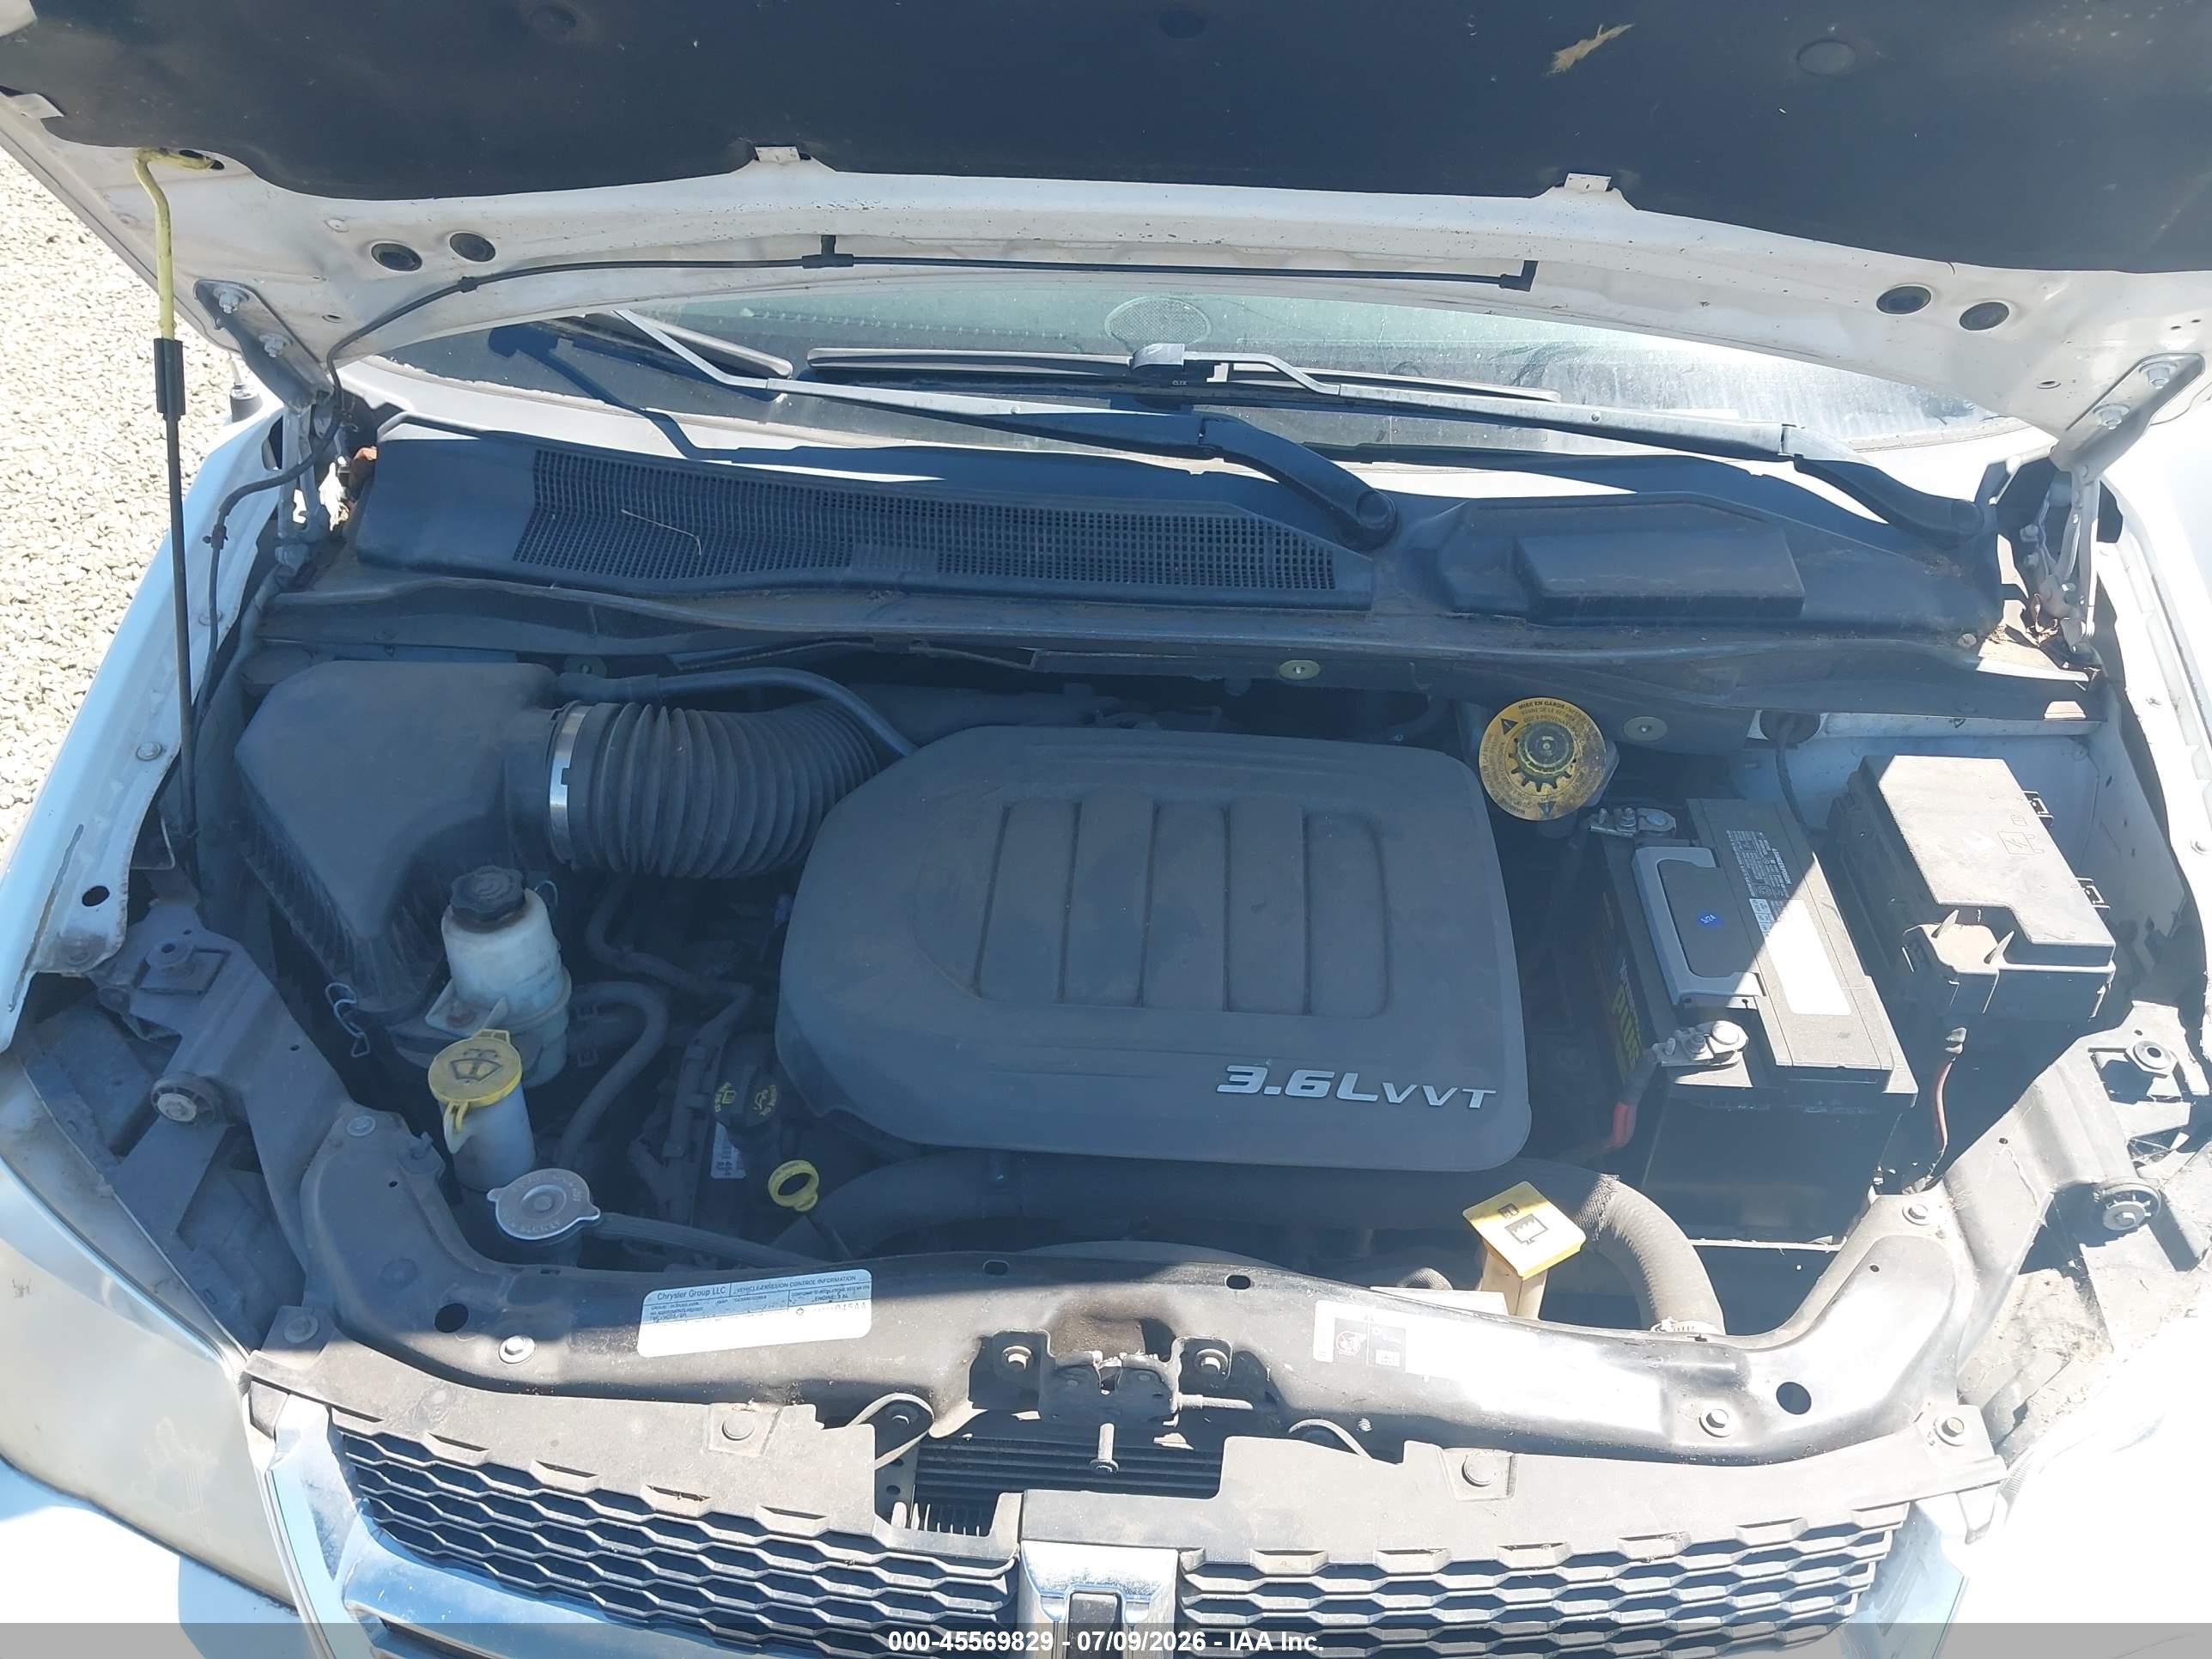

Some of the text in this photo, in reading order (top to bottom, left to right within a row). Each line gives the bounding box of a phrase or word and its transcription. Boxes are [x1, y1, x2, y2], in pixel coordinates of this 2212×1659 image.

[1518, 701, 1534, 709] MISE
[1544, 700, 1565, 709] GARDE
[737, 1285, 760, 1293] VEHICLE
[789, 1279, 816, 1288] CONTROL
[817, 1275, 857, 1285] INFORMATION
[657, 1286, 726, 1301] Chrysler Group LLC
